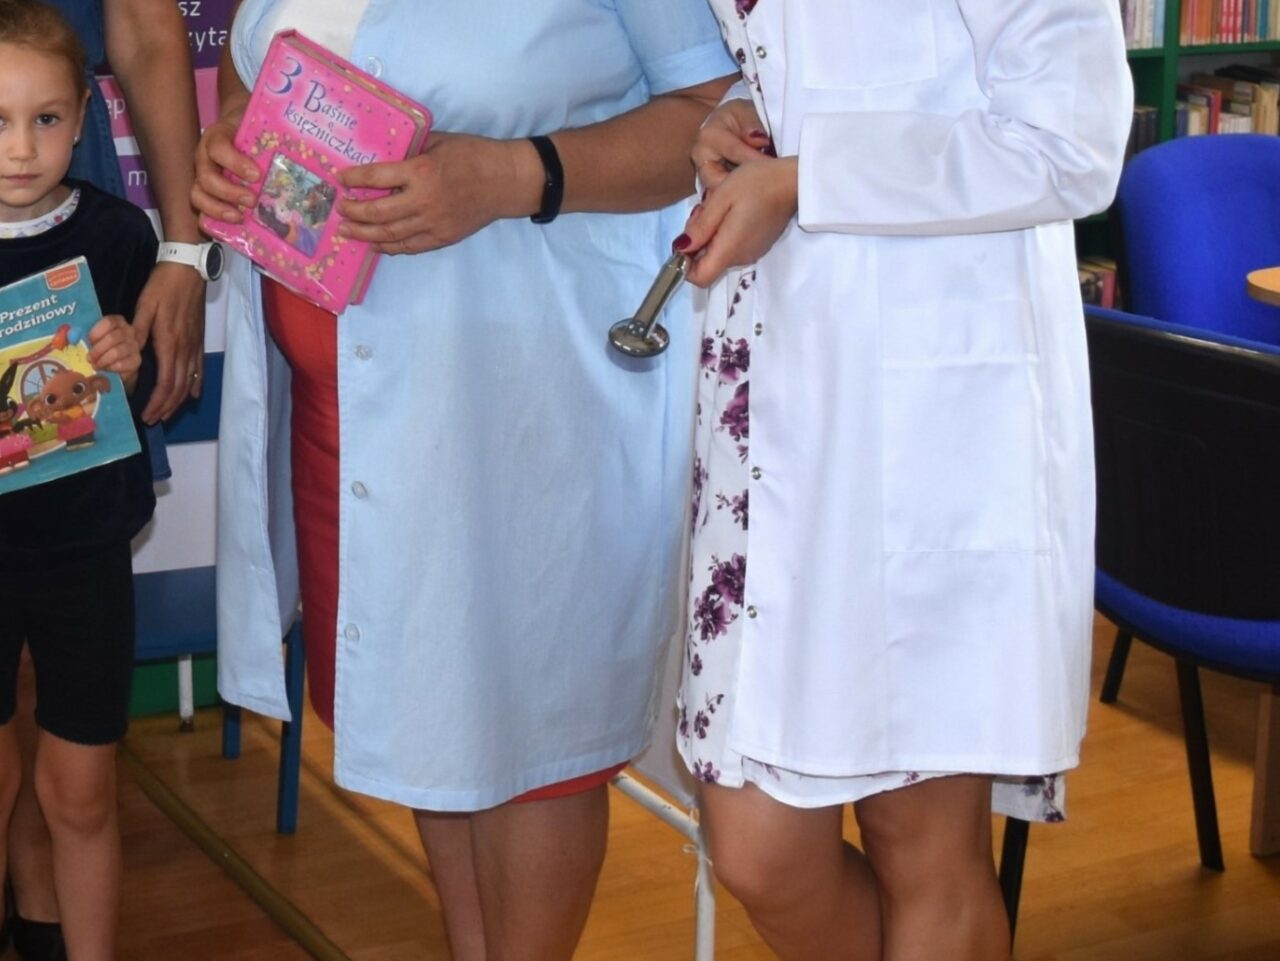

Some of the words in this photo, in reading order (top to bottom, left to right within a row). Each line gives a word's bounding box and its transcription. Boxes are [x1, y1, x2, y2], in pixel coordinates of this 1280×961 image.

[178, 1, 201, 16] sz
[265, 56, 302, 94] 3
[303, 80, 358, 131] Baśnie
